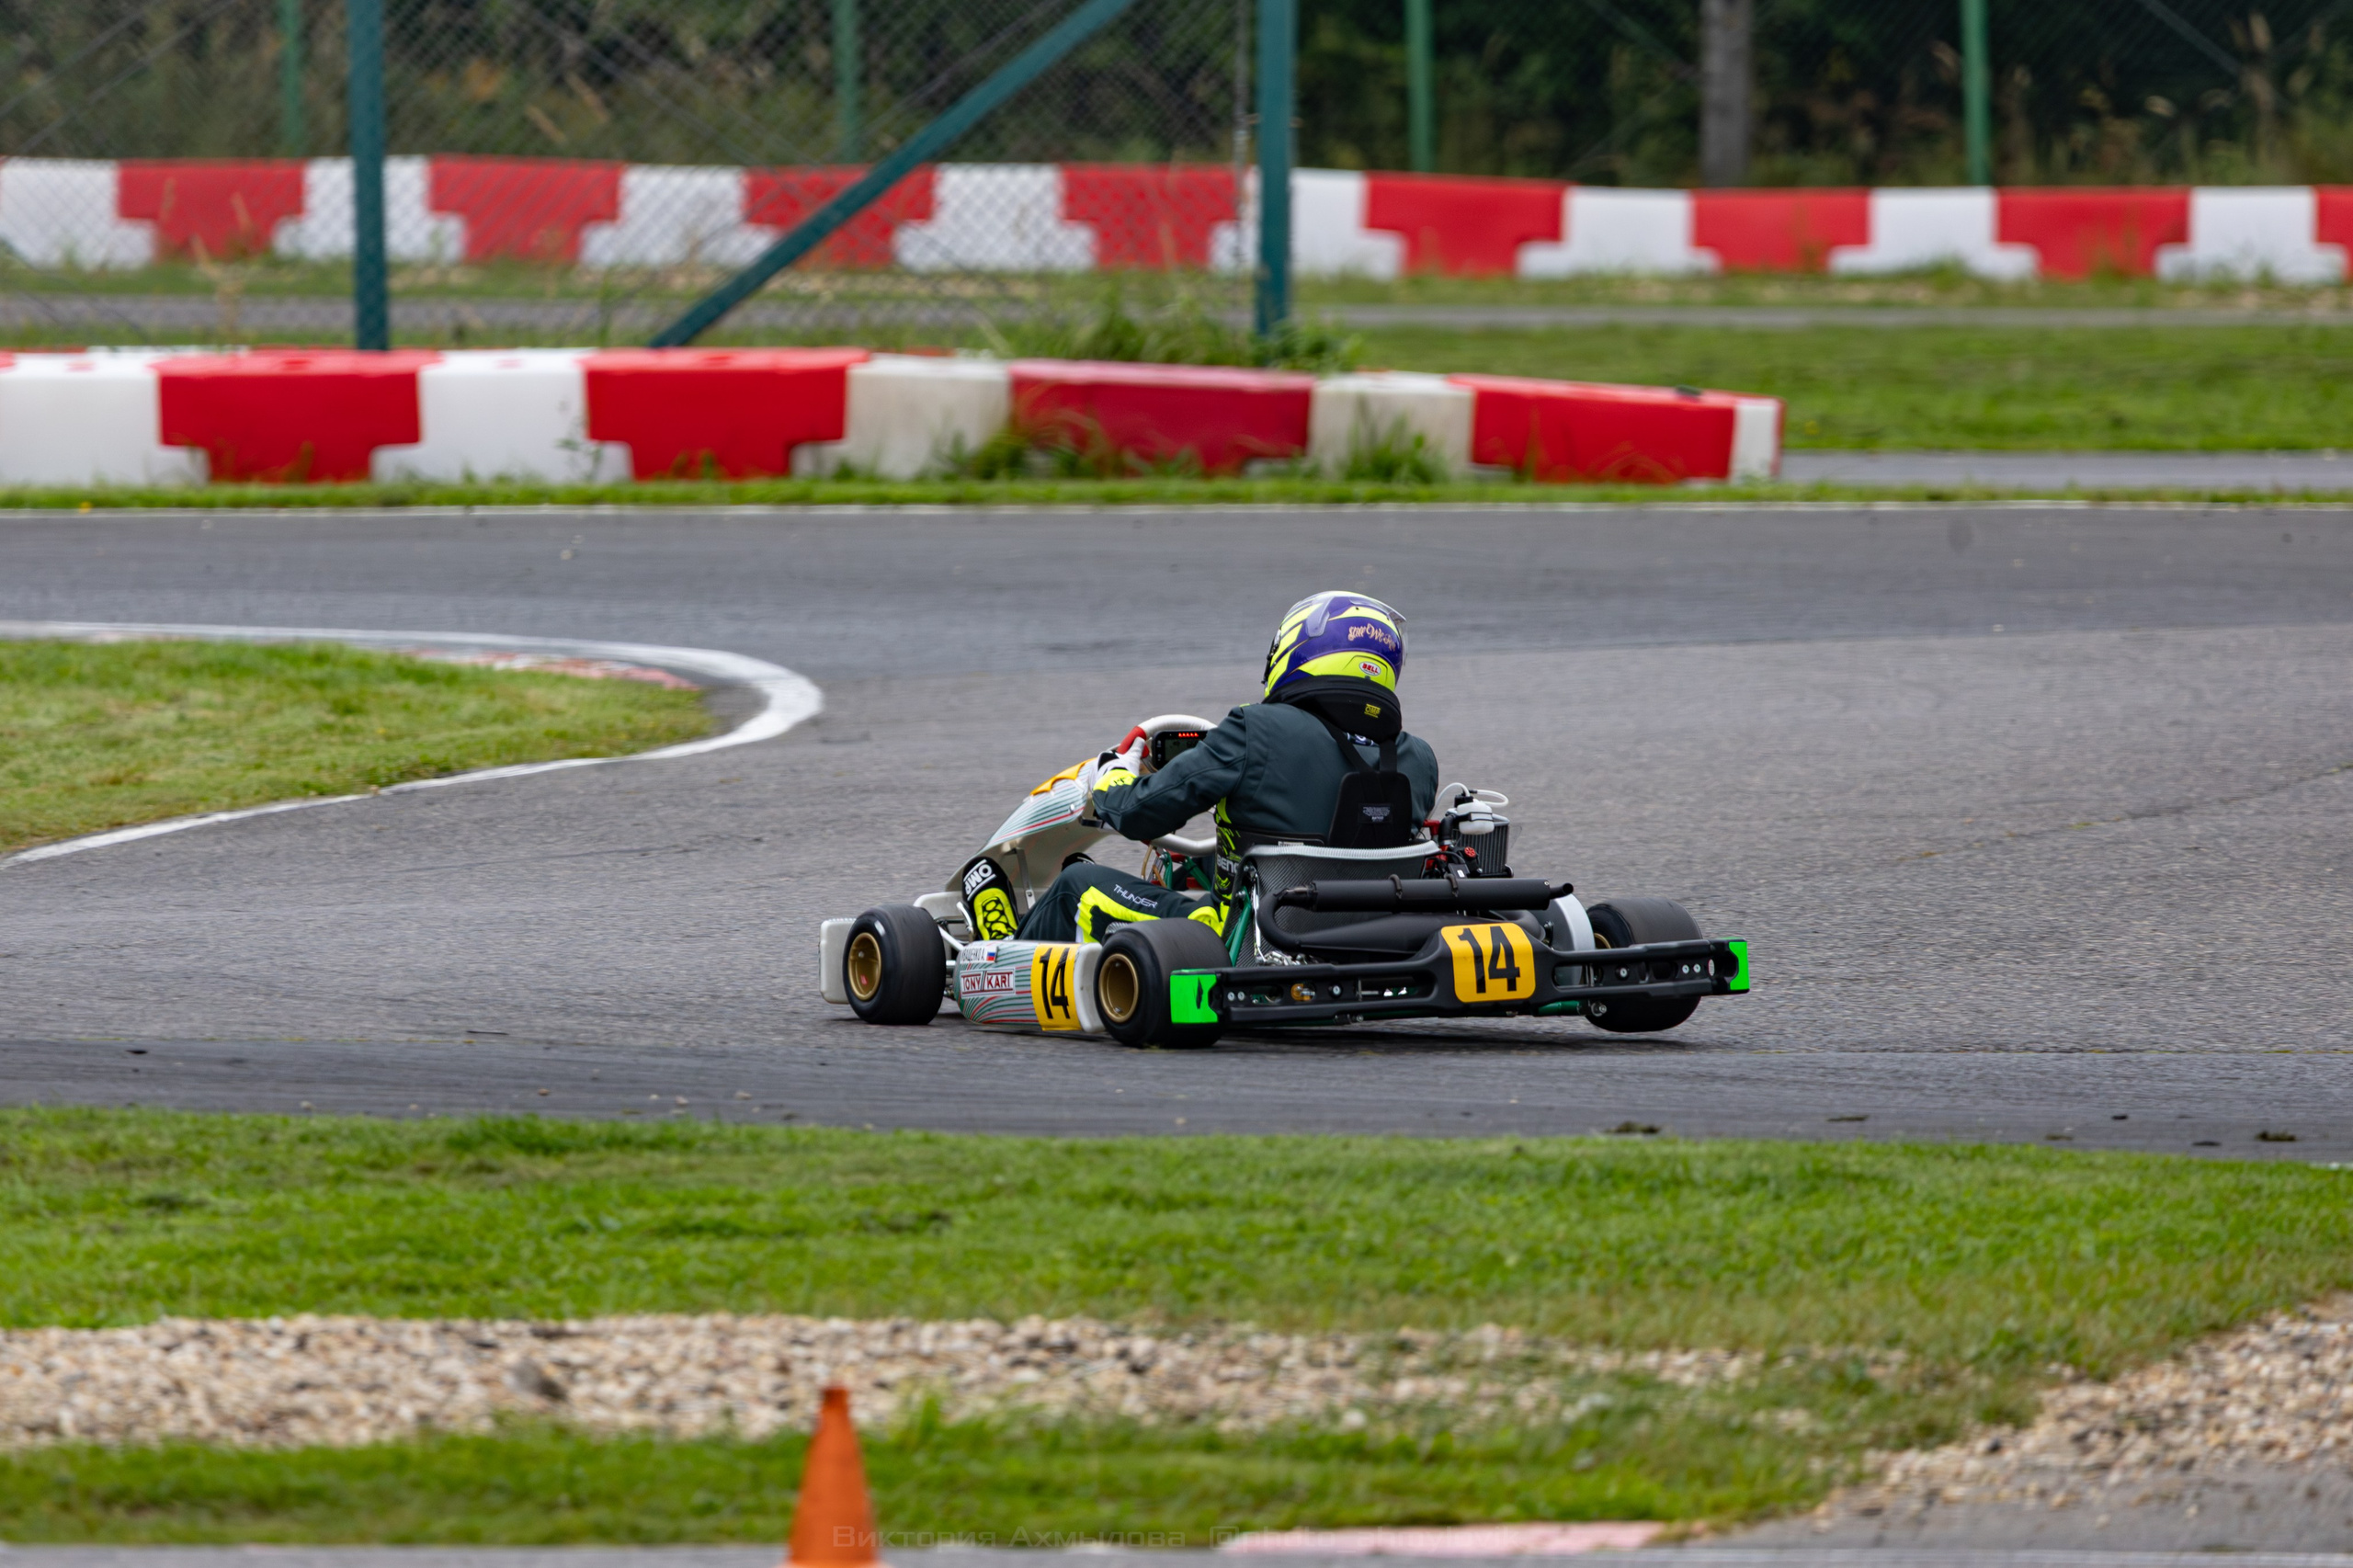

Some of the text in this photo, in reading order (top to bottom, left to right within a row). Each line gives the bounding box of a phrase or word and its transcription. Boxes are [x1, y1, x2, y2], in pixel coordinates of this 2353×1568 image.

[1362, 663, 1379, 675] BELL
[1364, 704, 1381, 717] OMP
[965, 864, 993, 895] OMP
[1113, 884, 1158, 909] THUNDER
[1457, 926, 1520, 994] 14
[961, 971, 1013, 991] TONY KART
[1040, 948, 1071, 1019] 14
